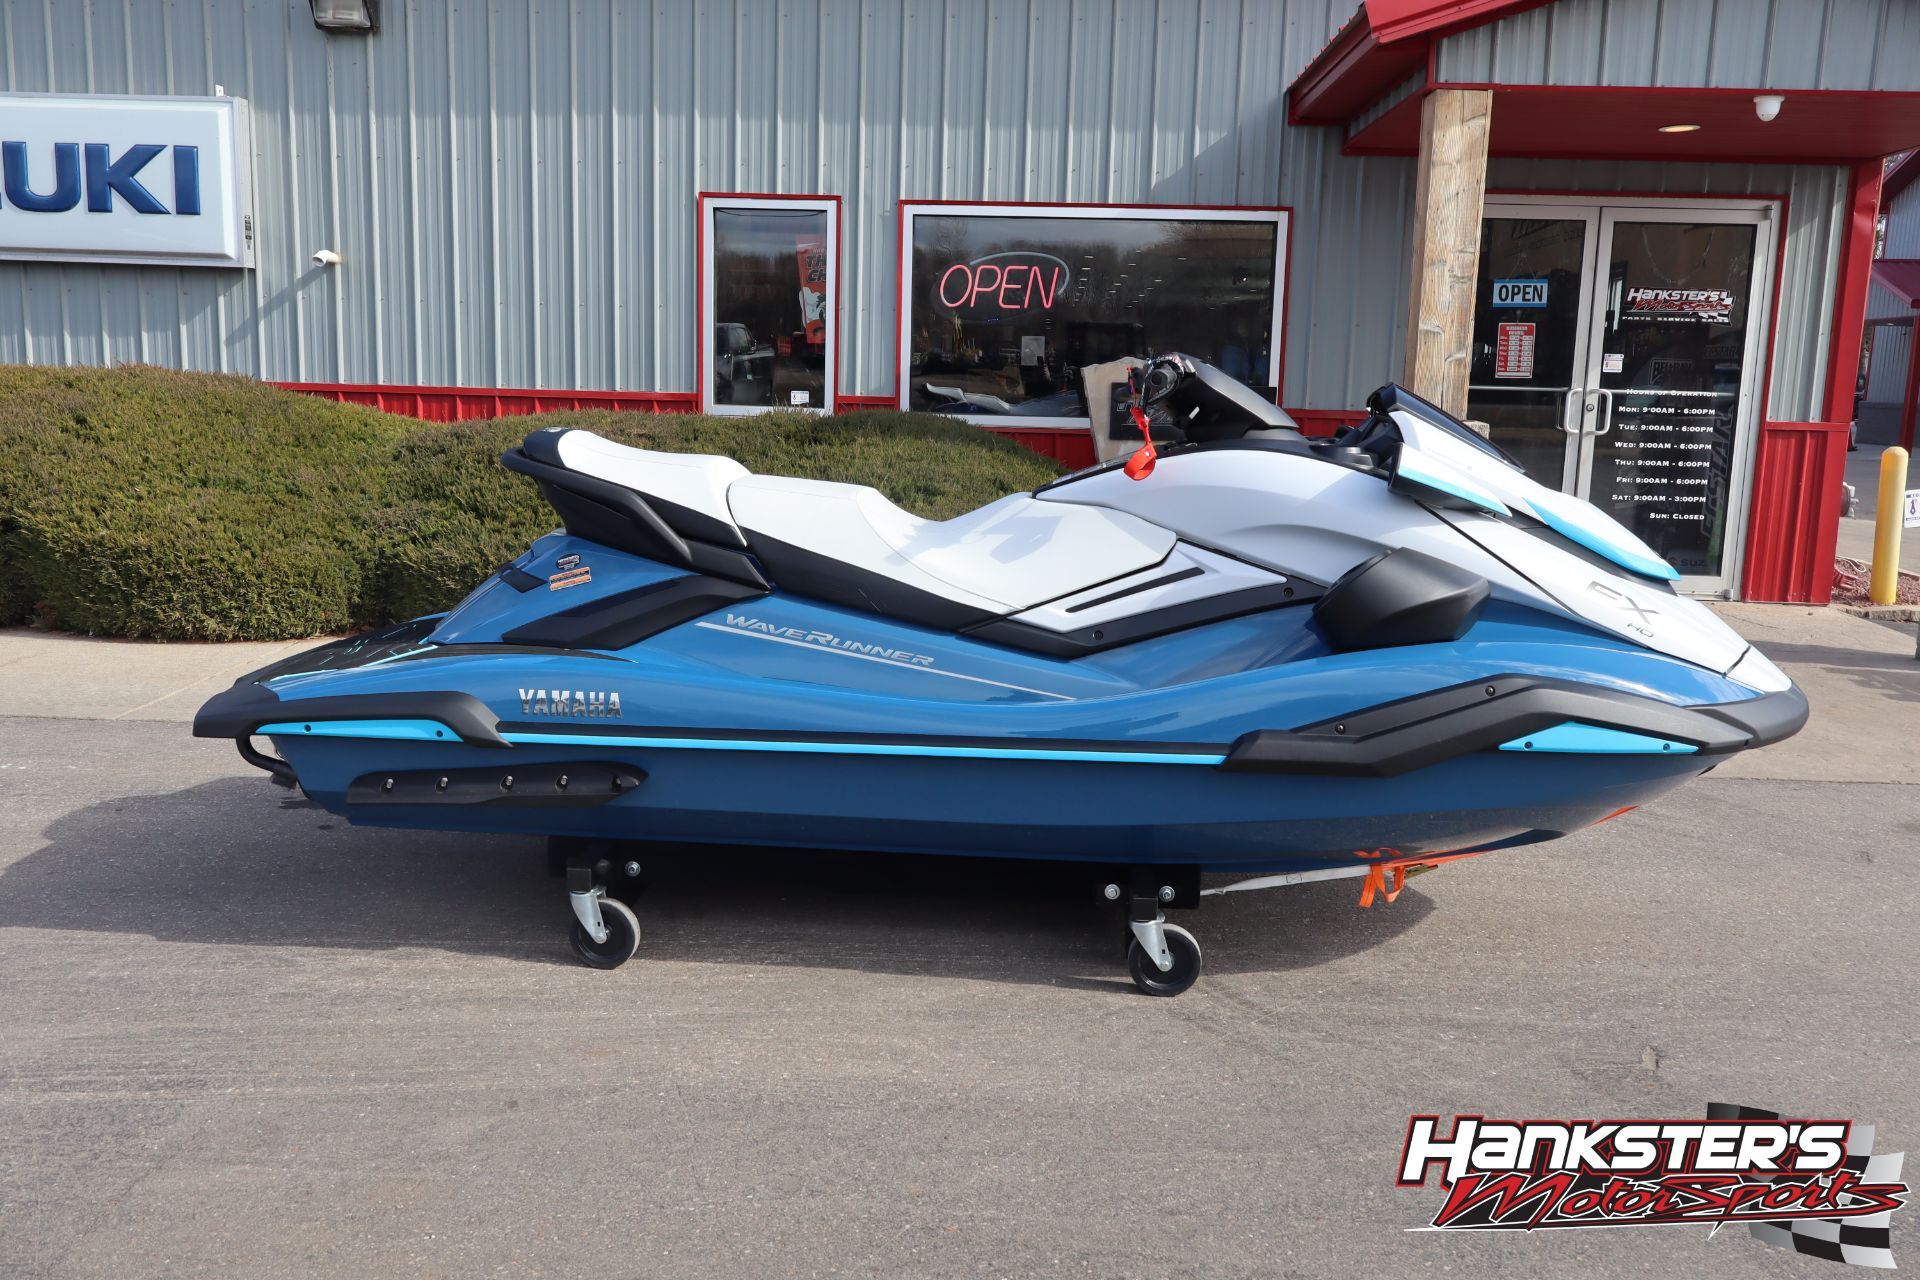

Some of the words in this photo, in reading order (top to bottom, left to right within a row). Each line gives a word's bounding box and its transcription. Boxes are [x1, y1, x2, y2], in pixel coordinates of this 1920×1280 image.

[0, 140, 201, 216] UKI
[939, 264, 1059, 310] OPEN
[1498, 284, 1544, 302] OPEN
[1642, 406, 1675, 414] 9:00AM
[1683, 408, 1716, 416] 6:00PM
[1640, 424, 1673, 432] 9:00AM
[1681, 425, 1714, 433] 6:00PM
[1638, 441, 1672, 449] 9:00AM
[1679, 443, 1712, 451] 6:00PM
[1637, 459, 1670, 467] 9:00AM
[1677, 460, 1710, 468] 6:00PM
[1635, 477, 1668, 485] 9:00AM
[1676, 478, 1708, 486] 6:00PM
[1633, 494, 1666, 502] 9:00AM
[1674, 495, 1707, 503] 3:00PM
[518, 687, 623, 720] YAMAHA
